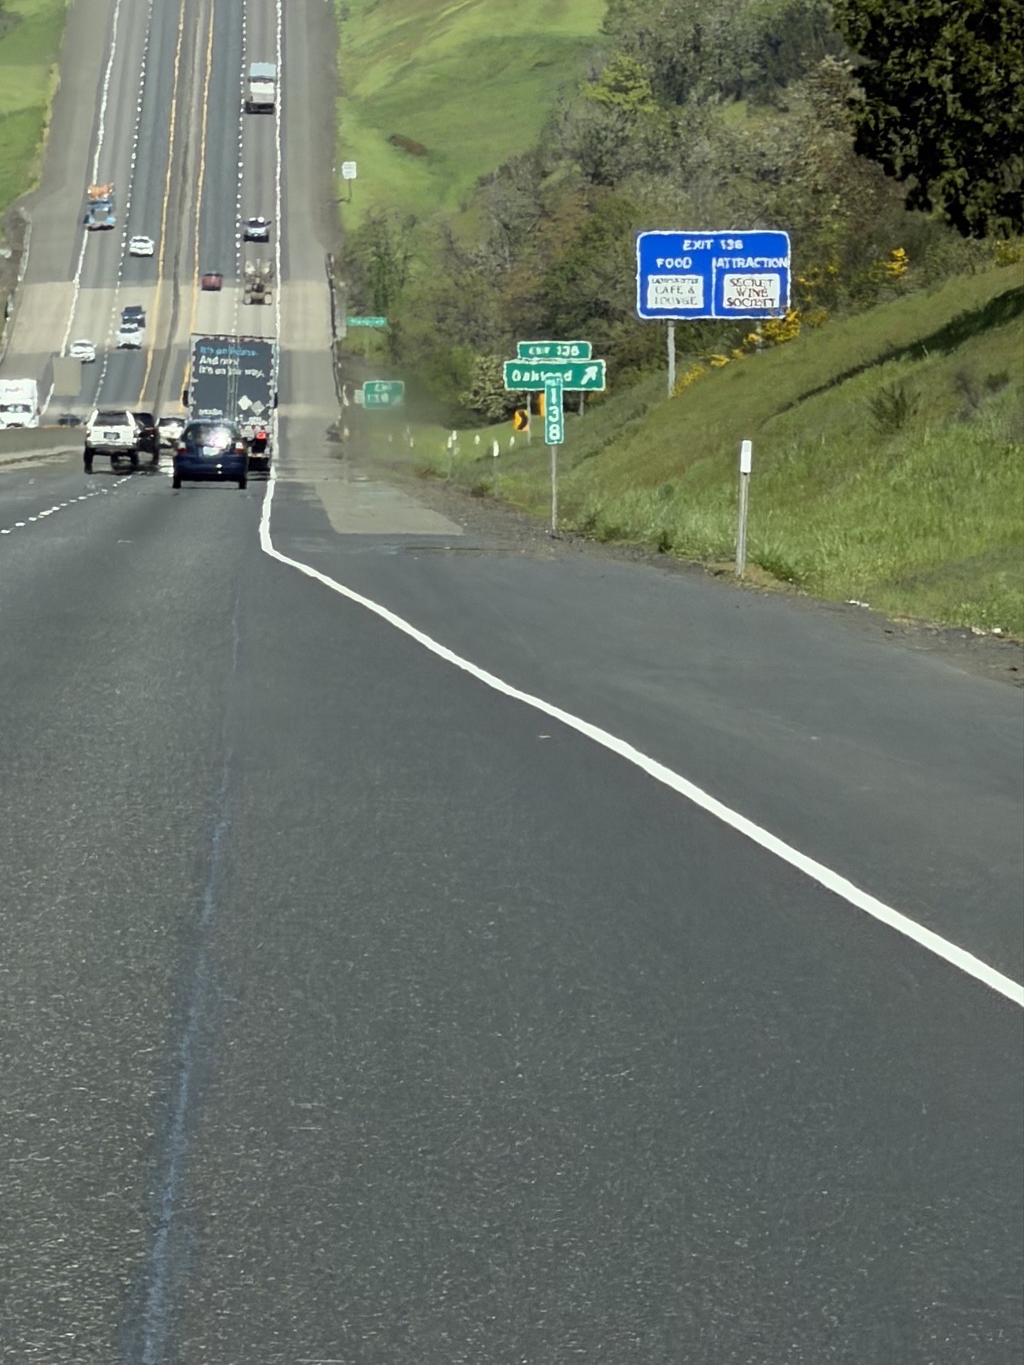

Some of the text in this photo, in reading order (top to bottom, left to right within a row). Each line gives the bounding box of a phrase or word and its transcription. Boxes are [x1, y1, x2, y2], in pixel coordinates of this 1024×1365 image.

[683, 239, 743, 251] EXIT 138
[656, 257, 692, 269] FOOD
[716, 257, 788, 269] ATTRACTION
[729, 278, 774, 287] SECRET
[736, 286, 768, 297] WINE
[654, 297, 698, 306] LOUNGE
[557, 345, 580, 356] 138
[511, 369, 573, 382] Oakld
